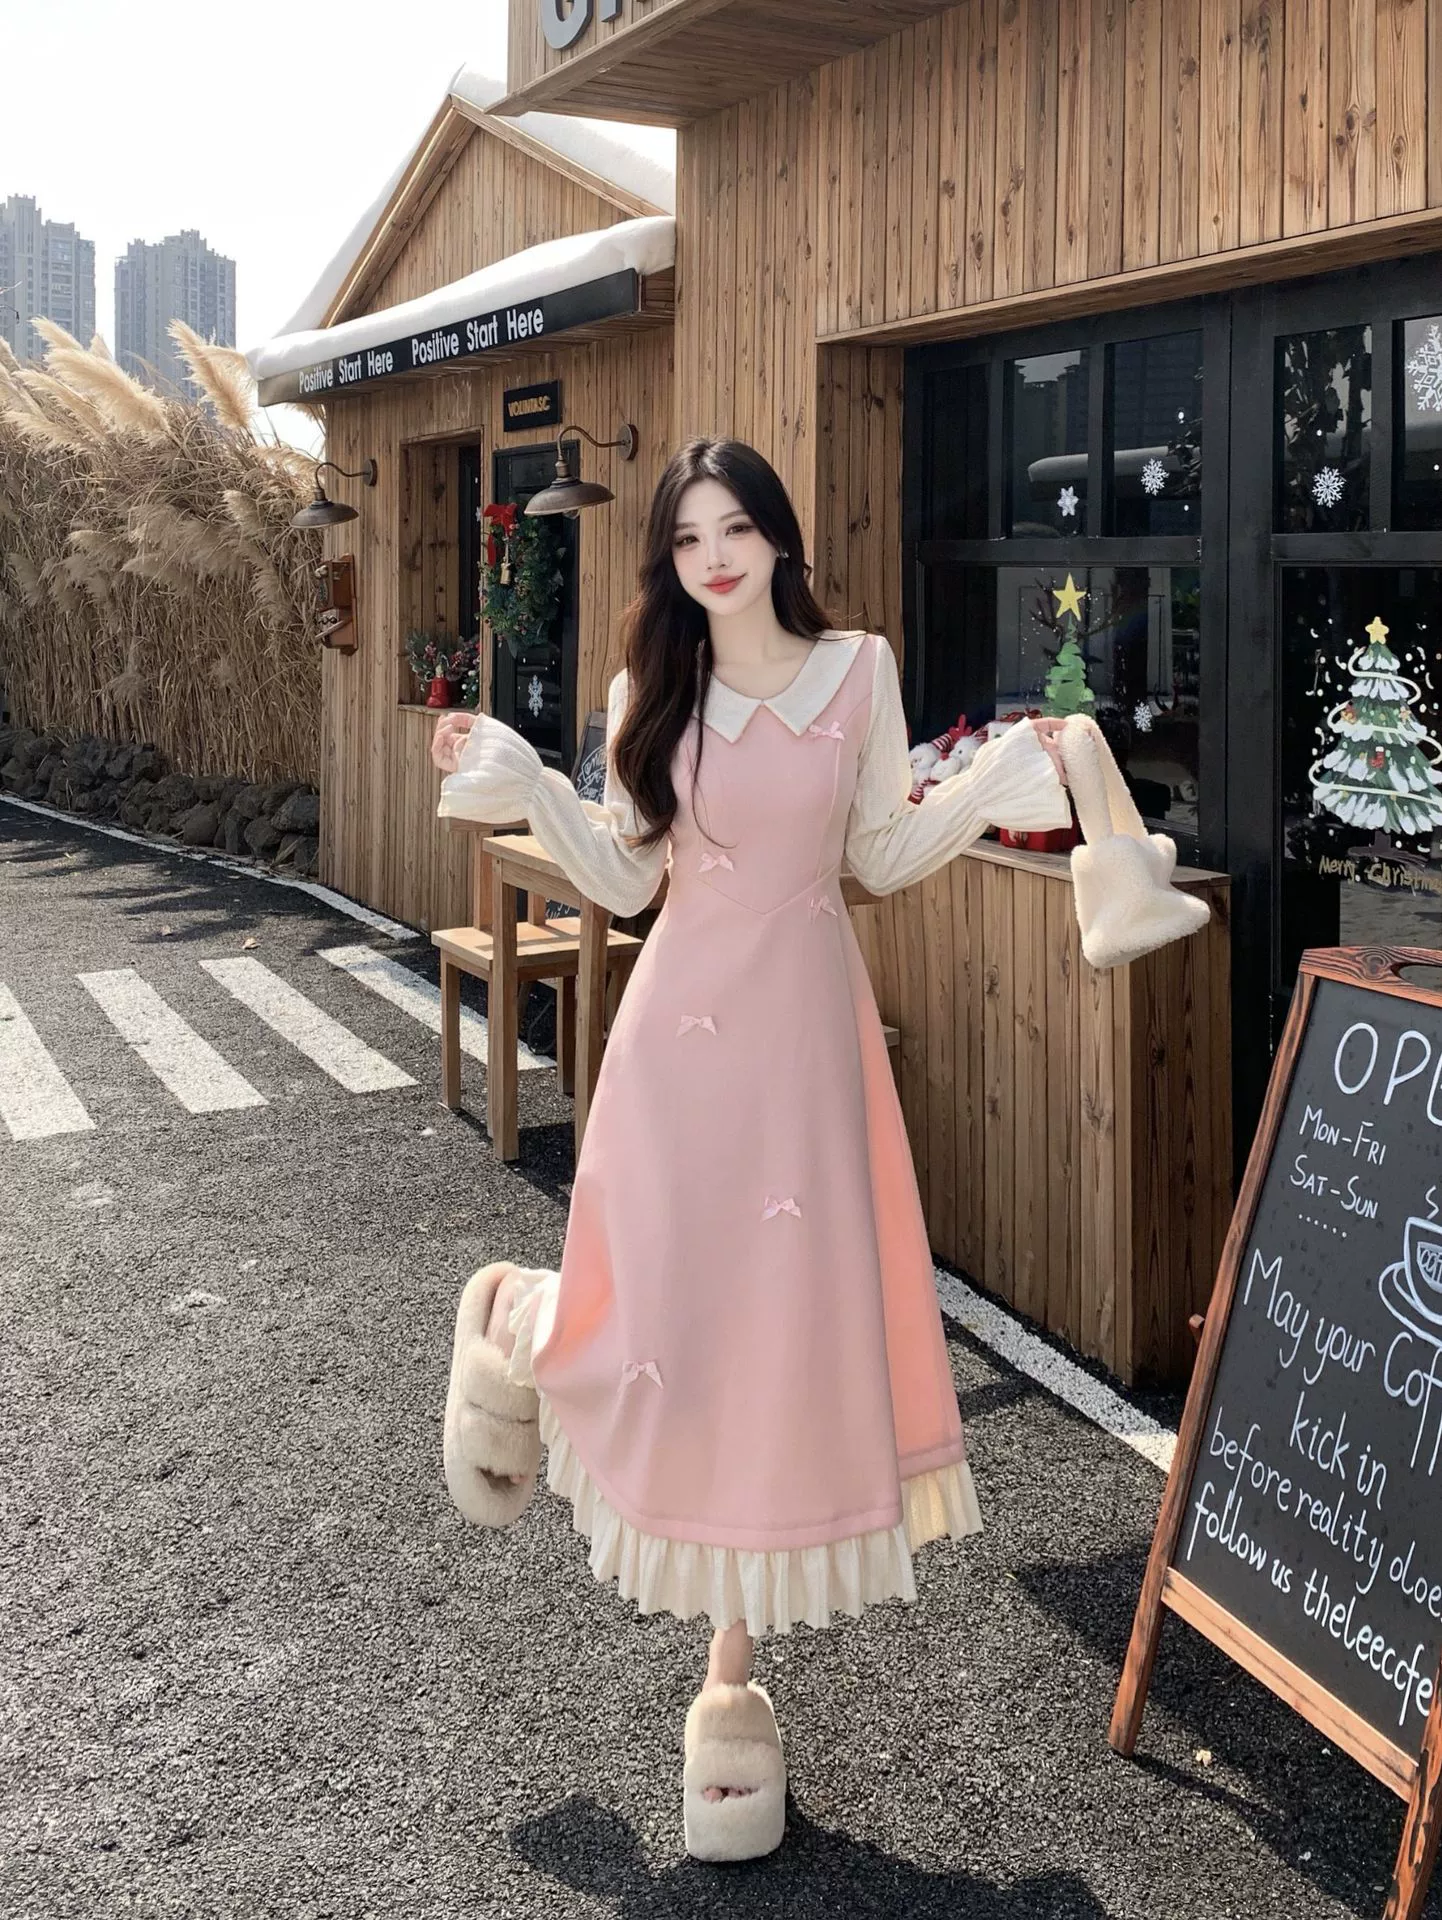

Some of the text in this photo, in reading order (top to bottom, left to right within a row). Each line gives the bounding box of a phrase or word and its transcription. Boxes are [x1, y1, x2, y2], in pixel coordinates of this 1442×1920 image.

[299, 350, 393, 394] Positive Start Here
[412, 308, 544, 366] Positive Start Here
[1243, 1248, 1310, 1368] May
[1303, 1317, 1377, 1385] your
[1289, 1391, 1387, 1510] kick in
[1186, 1480, 1267, 1572] follow
[1270, 1558, 1294, 1594] us
[1209, 1406, 1442, 1624] before reality doe
